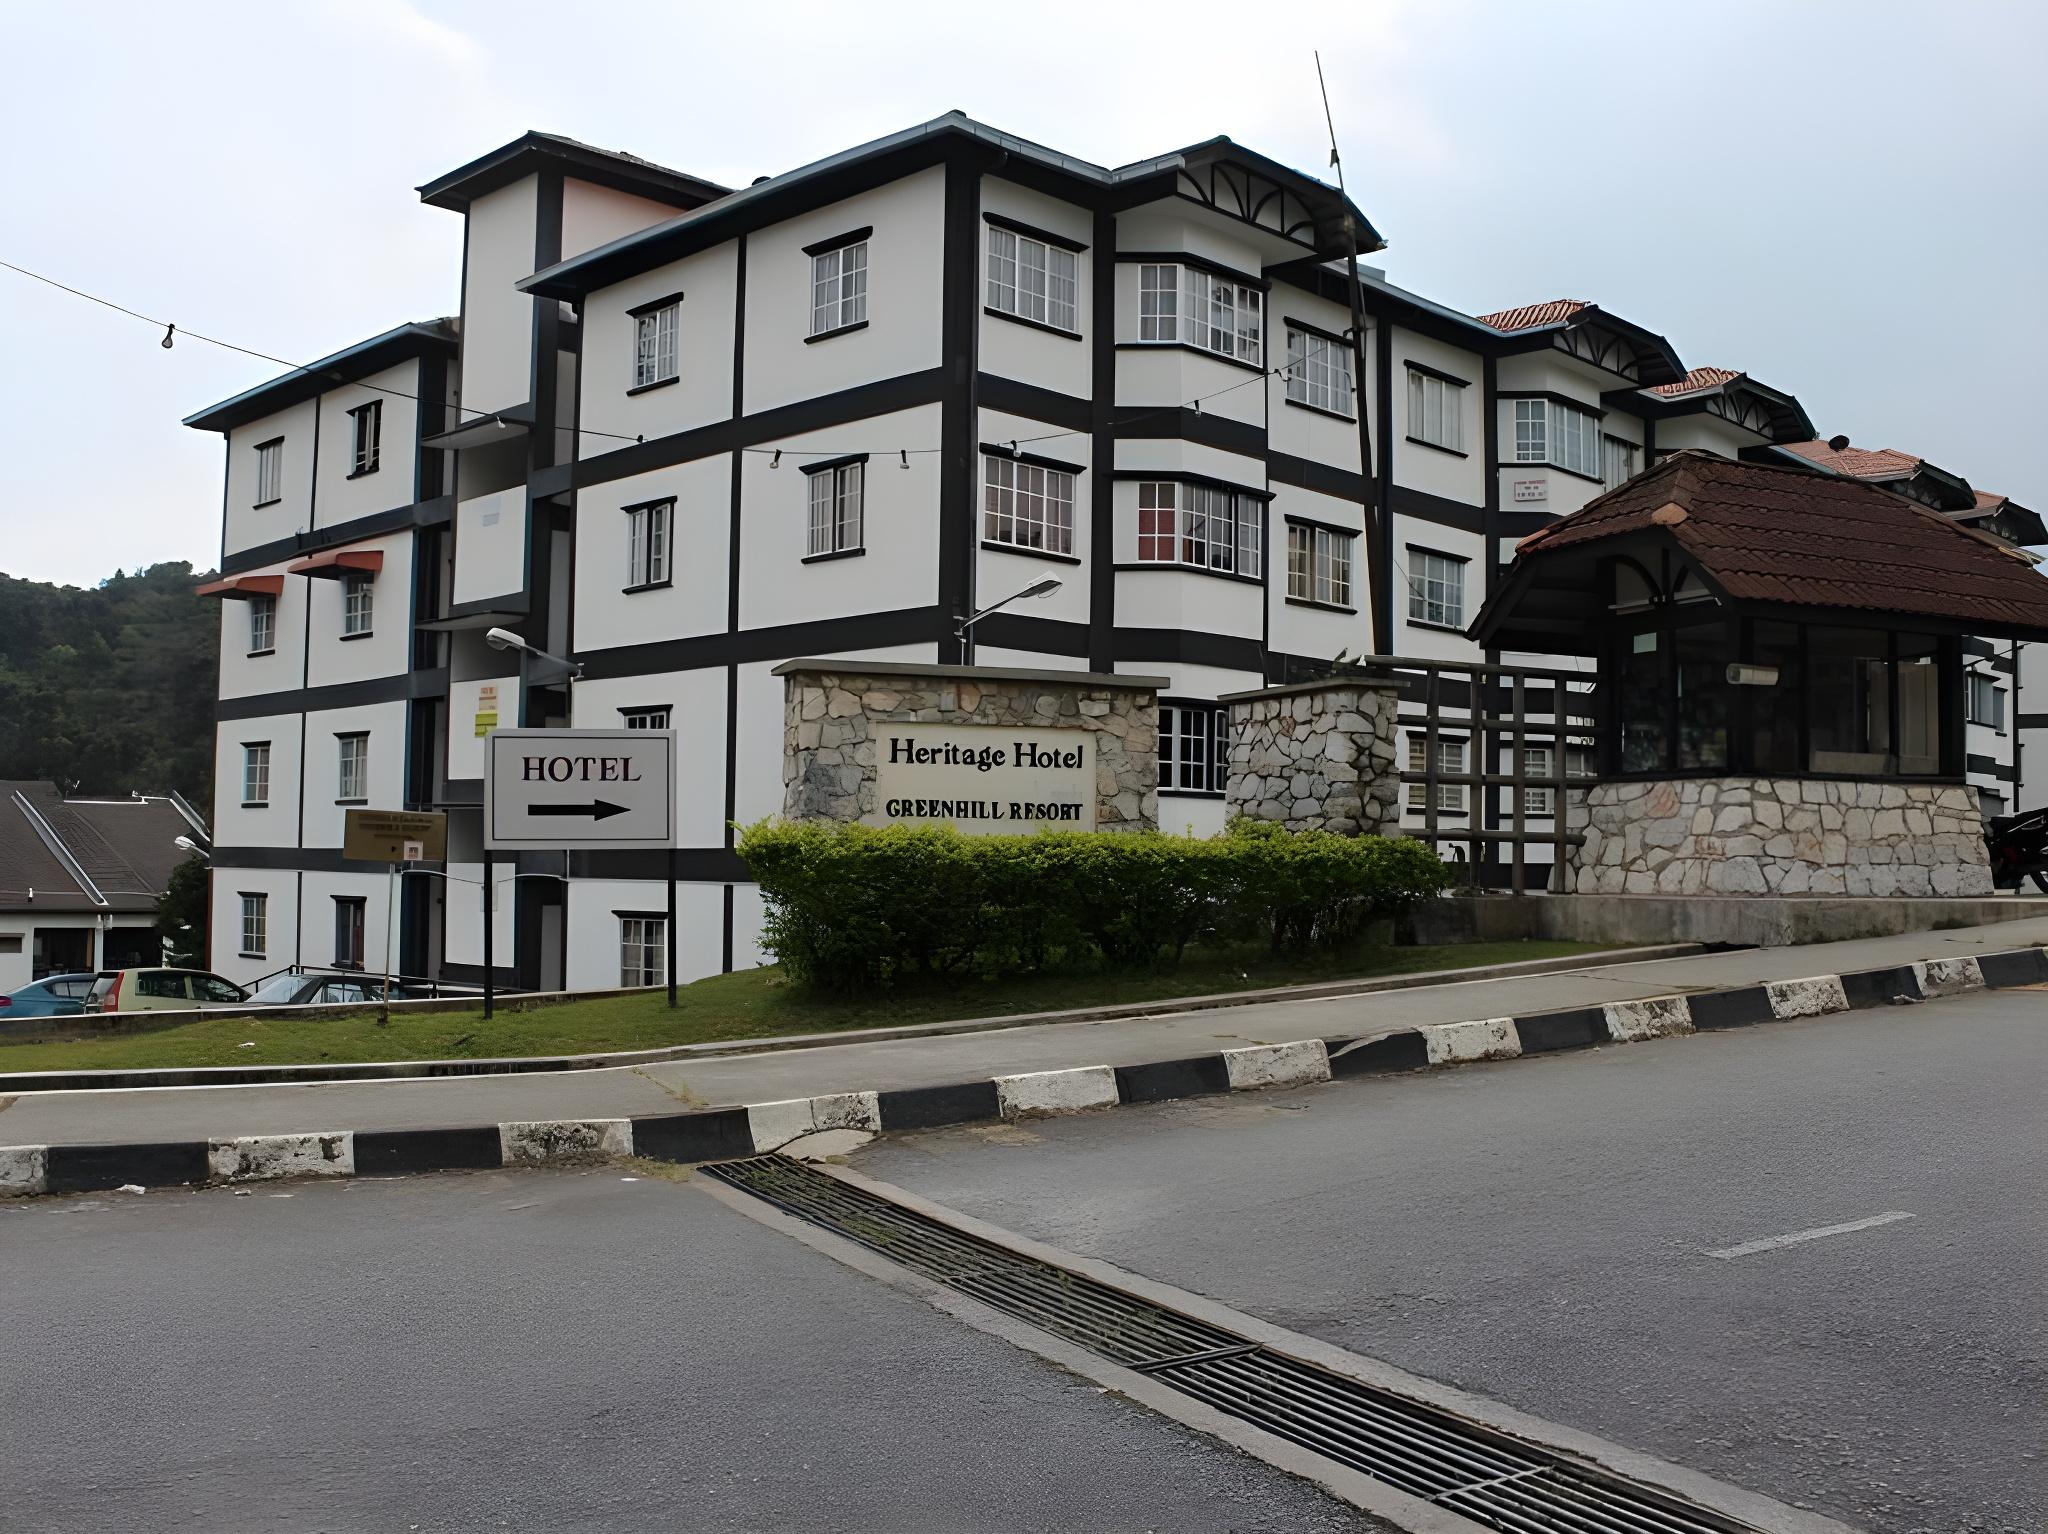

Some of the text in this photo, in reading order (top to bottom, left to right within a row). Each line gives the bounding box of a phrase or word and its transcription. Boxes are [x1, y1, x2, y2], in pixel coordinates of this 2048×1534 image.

[889, 738, 1084, 772] Heritage Hotel
[521, 756, 642, 782] HOTEL
[886, 799, 1083, 820] GREENHILL RESORT
